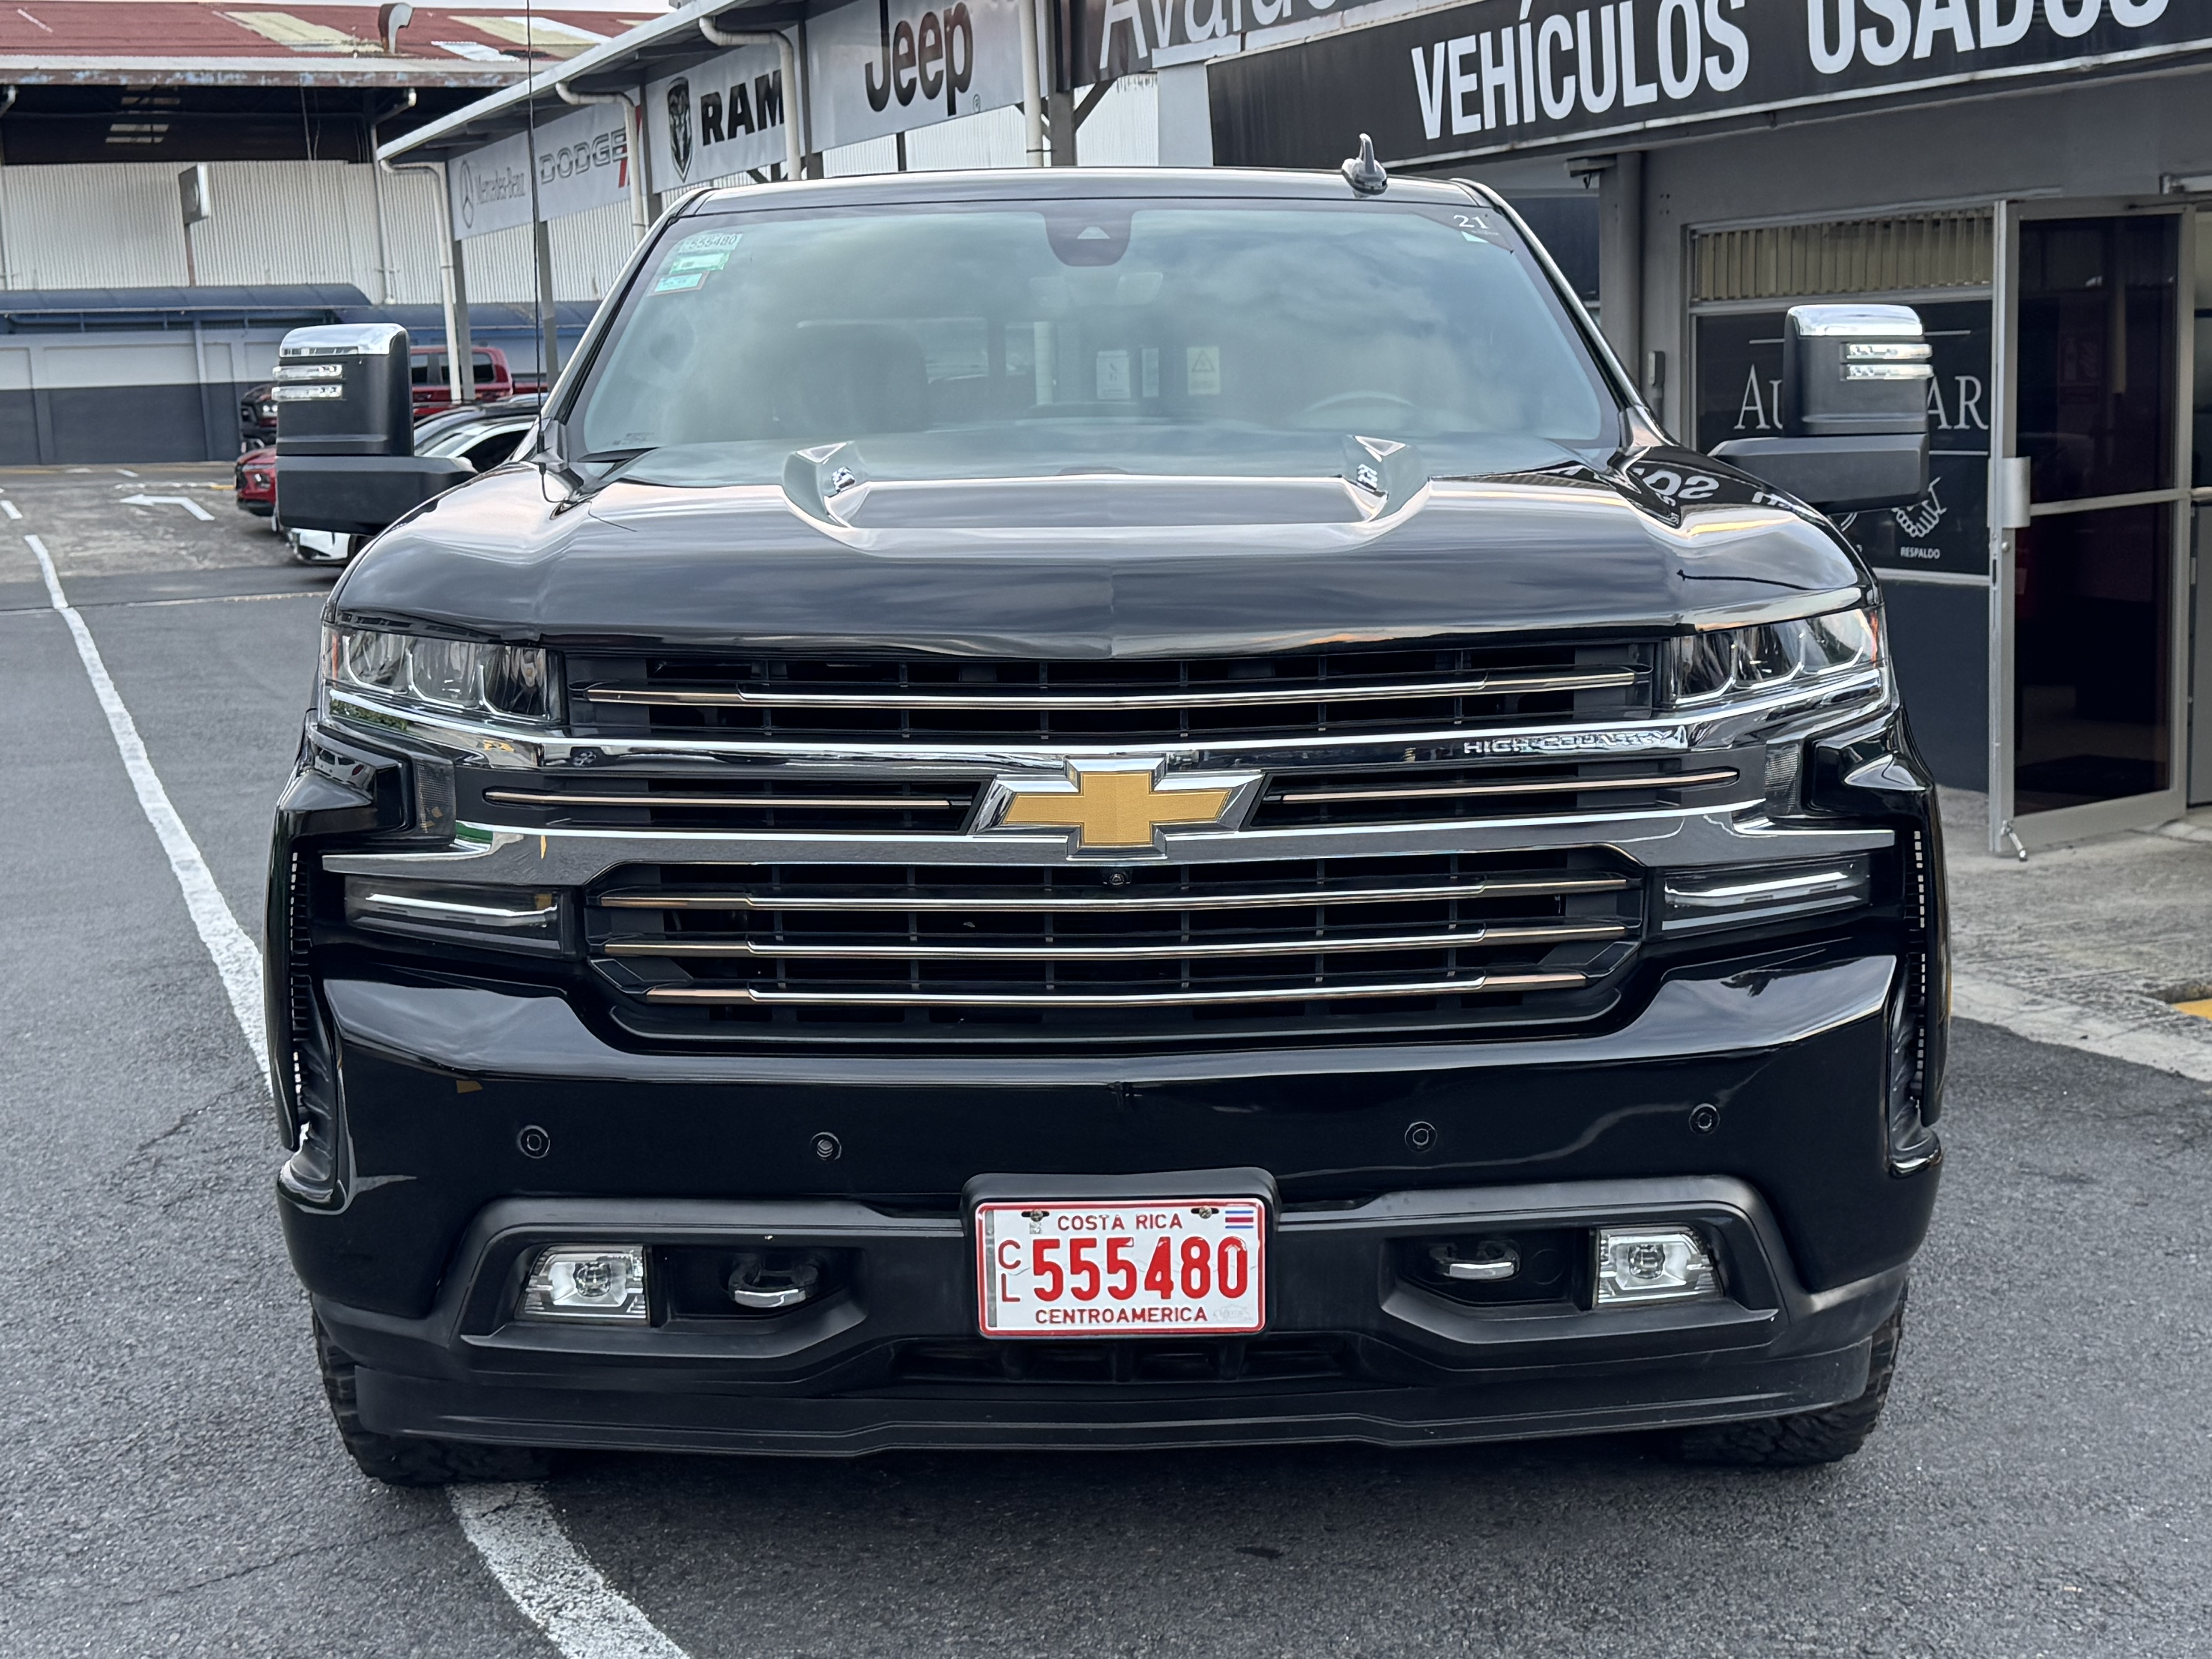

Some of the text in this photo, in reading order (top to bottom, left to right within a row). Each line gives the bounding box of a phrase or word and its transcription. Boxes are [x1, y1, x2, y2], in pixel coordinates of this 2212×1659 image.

[865, 0, 973, 117] Jeep
[1411, 0, 1750, 139] VEHÍCULOS
[700, 69, 784, 146] RAM
[539, 126, 629, 185] DODGE
[689, 234, 738, 249] 555480
[1453, 215, 1489, 229] 21
[1900, 546, 1941, 559] RESPALDO
[1058, 1213, 1183, 1231] COSTA RICA
[1032, 1236, 1248, 1302] 555480
[1035, 1306, 1208, 1325] CENTROAMERICA
